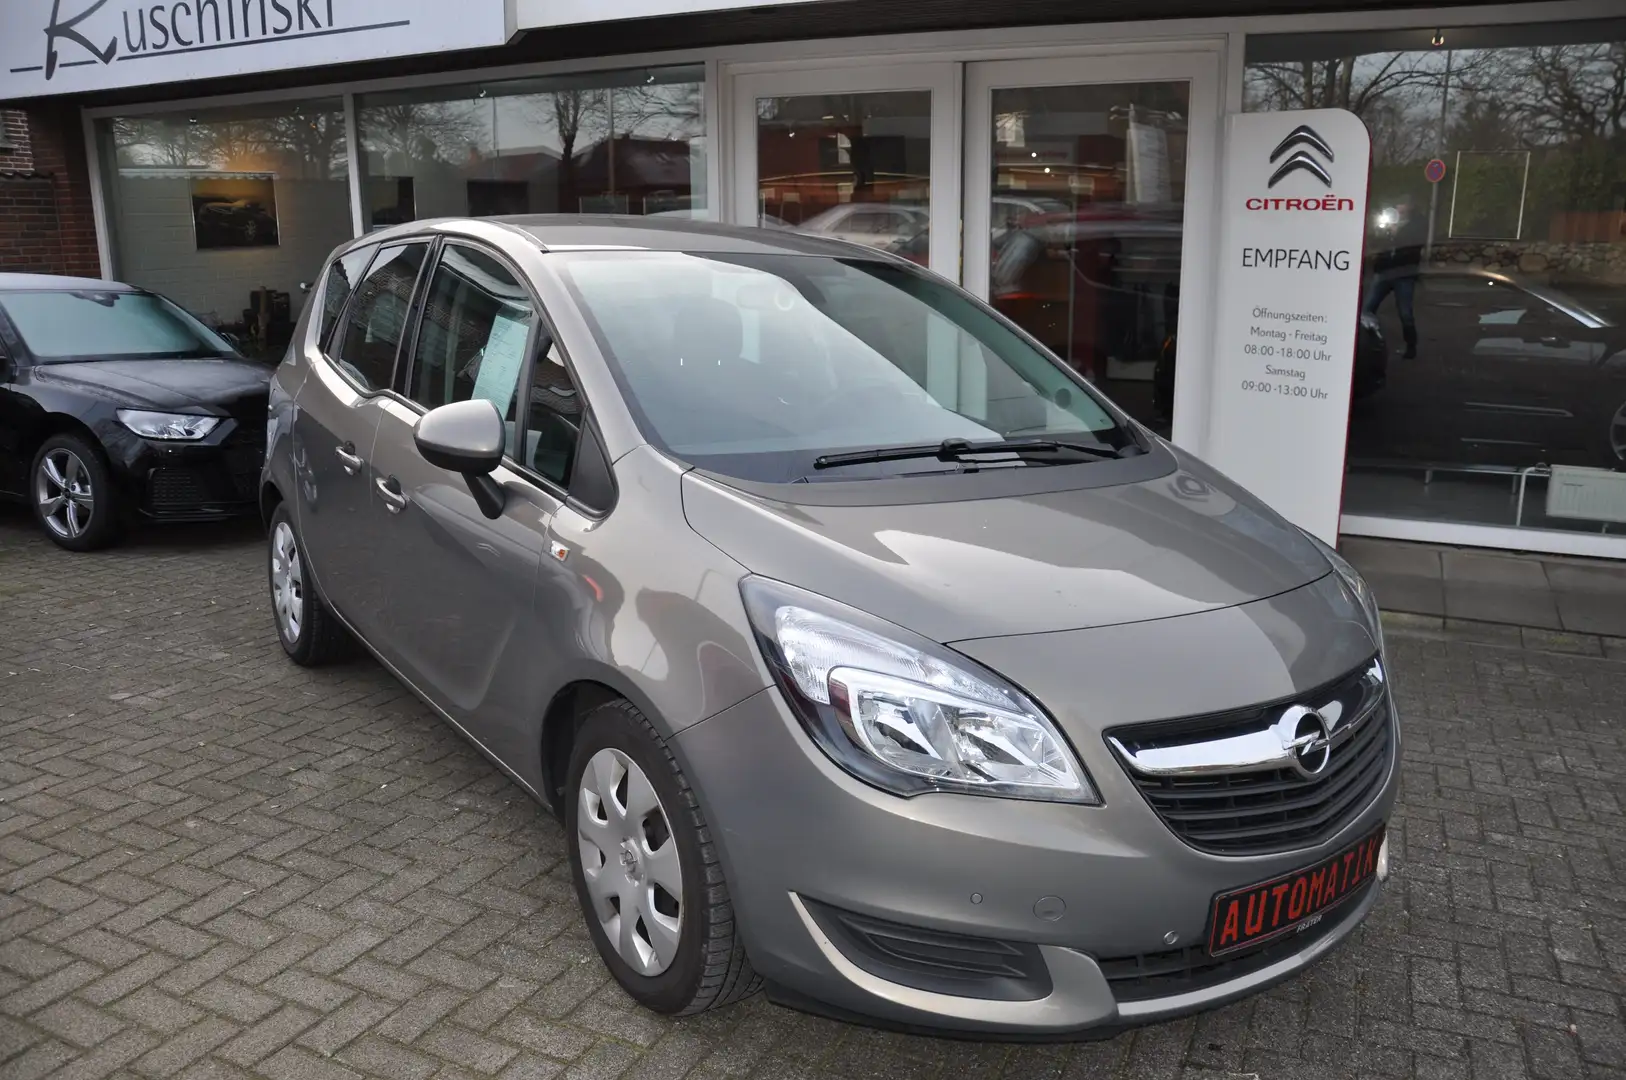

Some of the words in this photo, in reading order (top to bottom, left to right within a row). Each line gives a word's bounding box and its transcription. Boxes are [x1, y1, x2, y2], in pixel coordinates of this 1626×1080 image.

[1242, 247, 1350, 271] EMPFANG
[1252, 305, 1328, 323] Öffnungszeiten:
[1250, 326, 1286, 342] Montag
[1295, 329, 1328, 345] Freitag
[1244, 344, 1274, 356] 08:00
[1313, 350, 1332, 361] Uhr
[1265, 364, 1306, 381] Samstag
[1241, 380, 1272, 393] 09:00
[1310, 387, 1328, 399] Uhr
[1220, 836, 1379, 945] AUTOMATIK
